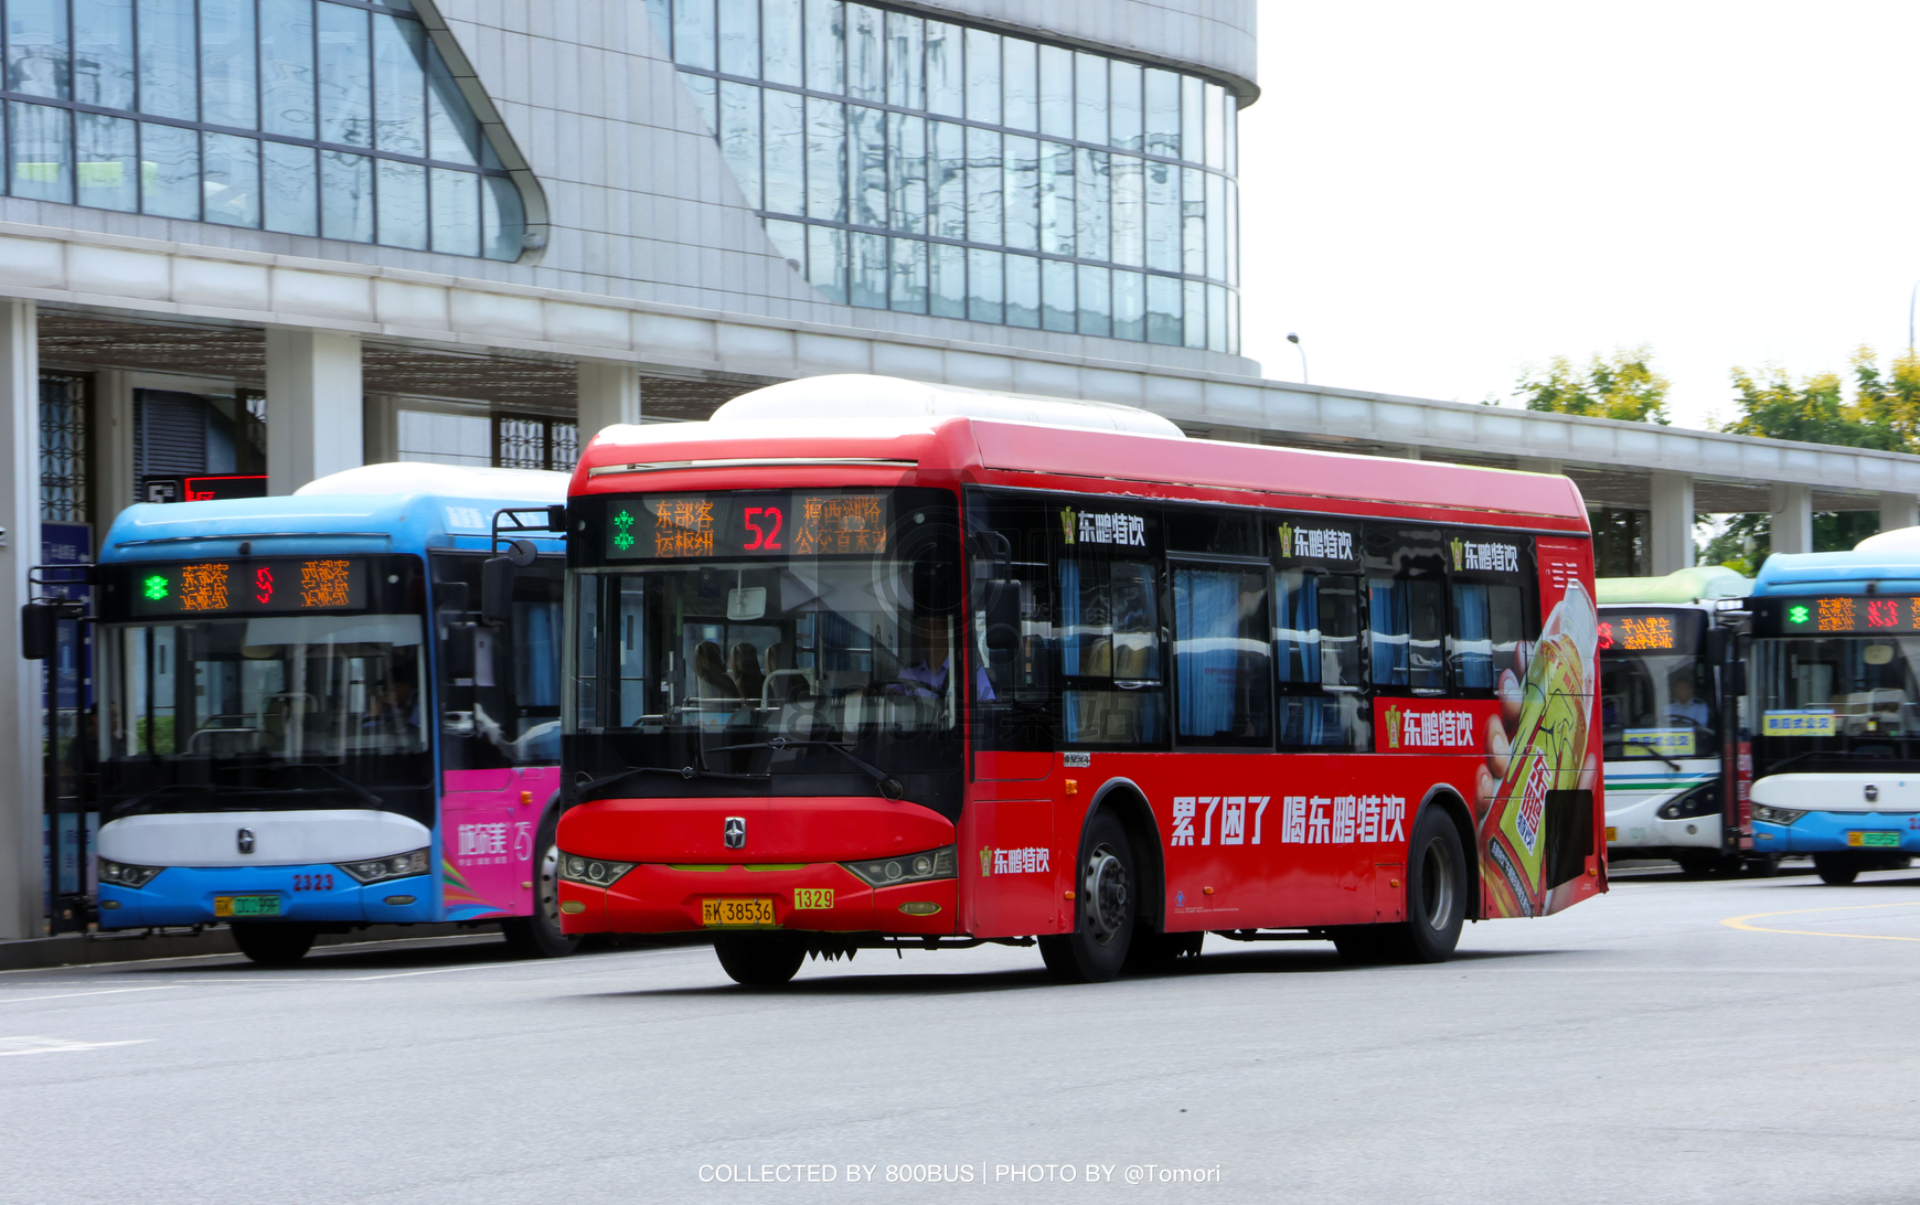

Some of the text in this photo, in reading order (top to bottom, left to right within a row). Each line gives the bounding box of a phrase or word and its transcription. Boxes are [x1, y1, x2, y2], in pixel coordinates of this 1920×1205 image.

[655, 500, 714, 529] 东部客
[803, 497, 882, 527] 瘦西湖路
[744, 507, 783, 550] 52
[1078, 510, 1145, 546] 东鹏特饮
[1294, 526, 1353, 560] 东鹏特饮
[655, 530, 714, 557] 运枢纽
[1464, 541, 1519, 572] 东鹏特饮
[1403, 709, 1474, 746] 东鹏特饮
[1171, 794, 1406, 846] 累了困了 喝东鹏特饮
[994, 847, 1050, 874] 东鹏特饮
[293, 874, 334, 891] 2323
[796, 890, 833, 908] 1329
